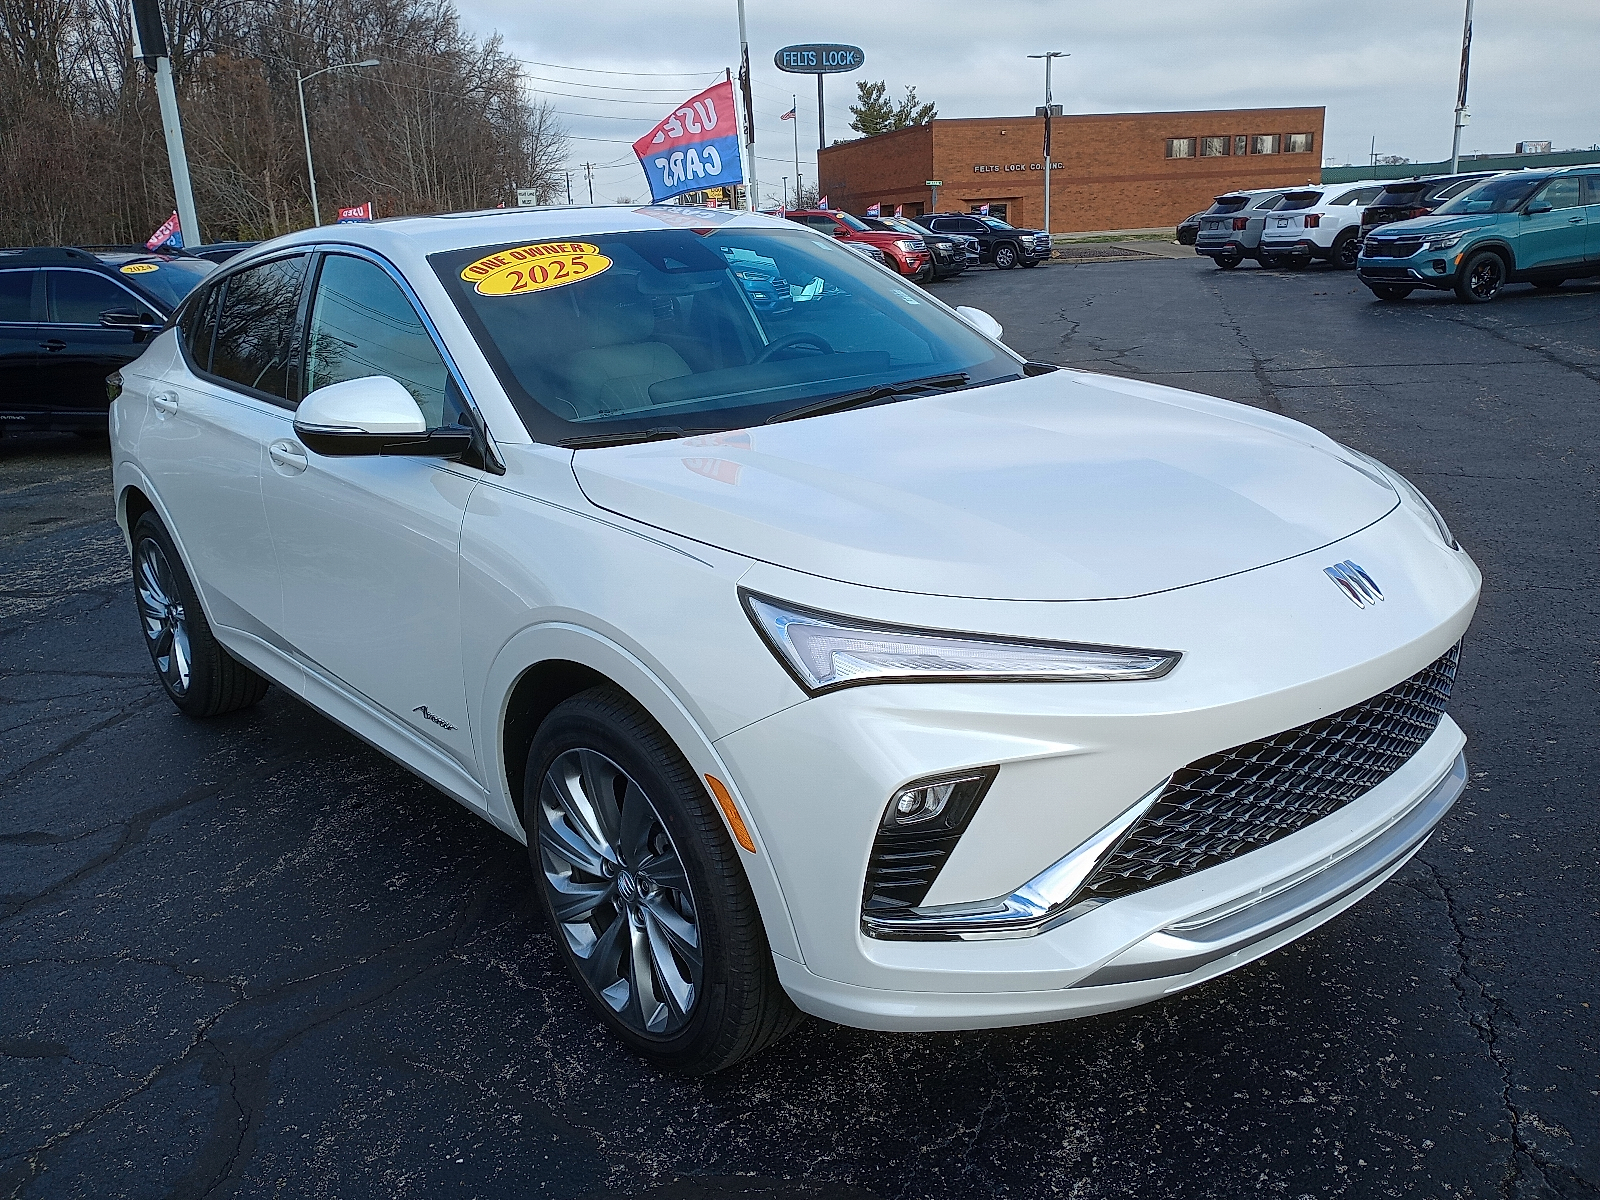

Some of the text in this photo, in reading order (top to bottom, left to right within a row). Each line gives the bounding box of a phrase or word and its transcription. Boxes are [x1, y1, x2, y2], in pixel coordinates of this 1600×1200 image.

[783, 51, 817, 66] FELTS
[822, 50, 855, 66] LOCK
[974, 165, 1000, 173] FELTS
[1004, 163, 1026, 172] LOCK
[468, 243, 586, 275] ONE OWNER
[505, 255, 589, 292] 2025
